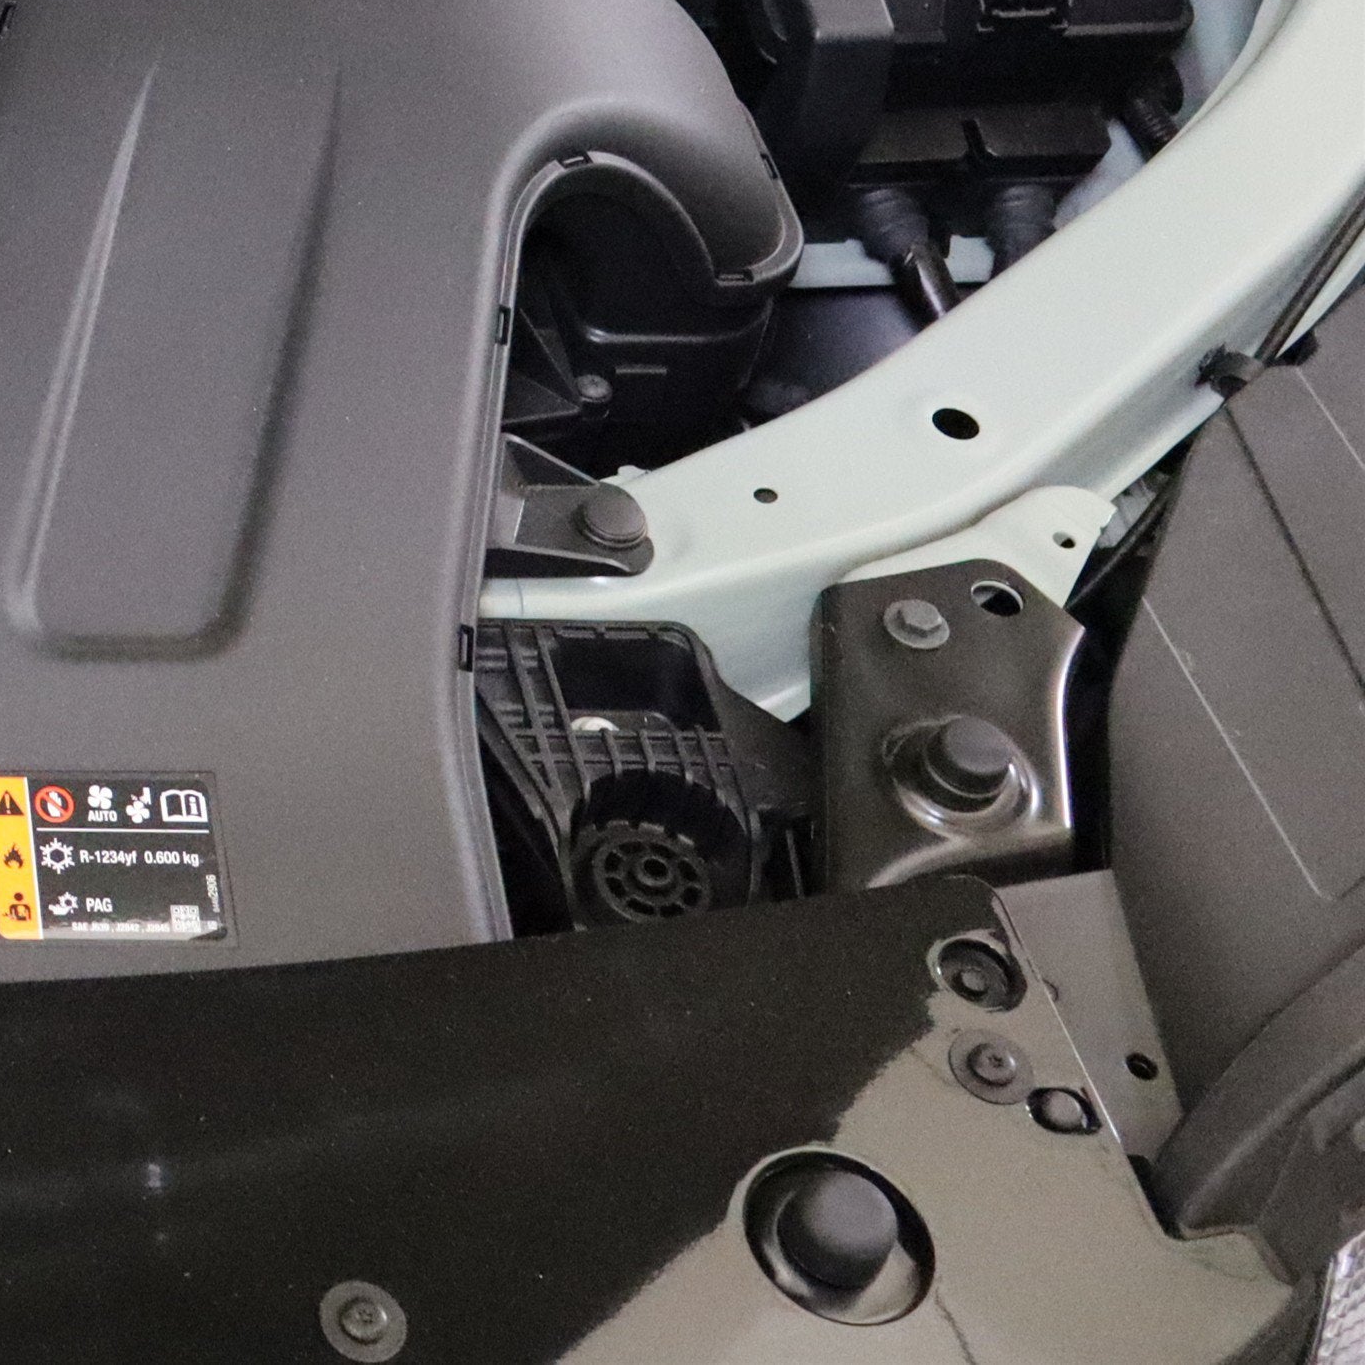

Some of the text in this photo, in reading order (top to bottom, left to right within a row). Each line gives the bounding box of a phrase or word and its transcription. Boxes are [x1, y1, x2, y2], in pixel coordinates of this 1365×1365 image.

[88, 810, 117, 822] AUTO
[79, 850, 200, 867] R-1234yf 0.600 kg
[86, 897, 113, 912] PAG
[72, 922, 88, 931] SAE
